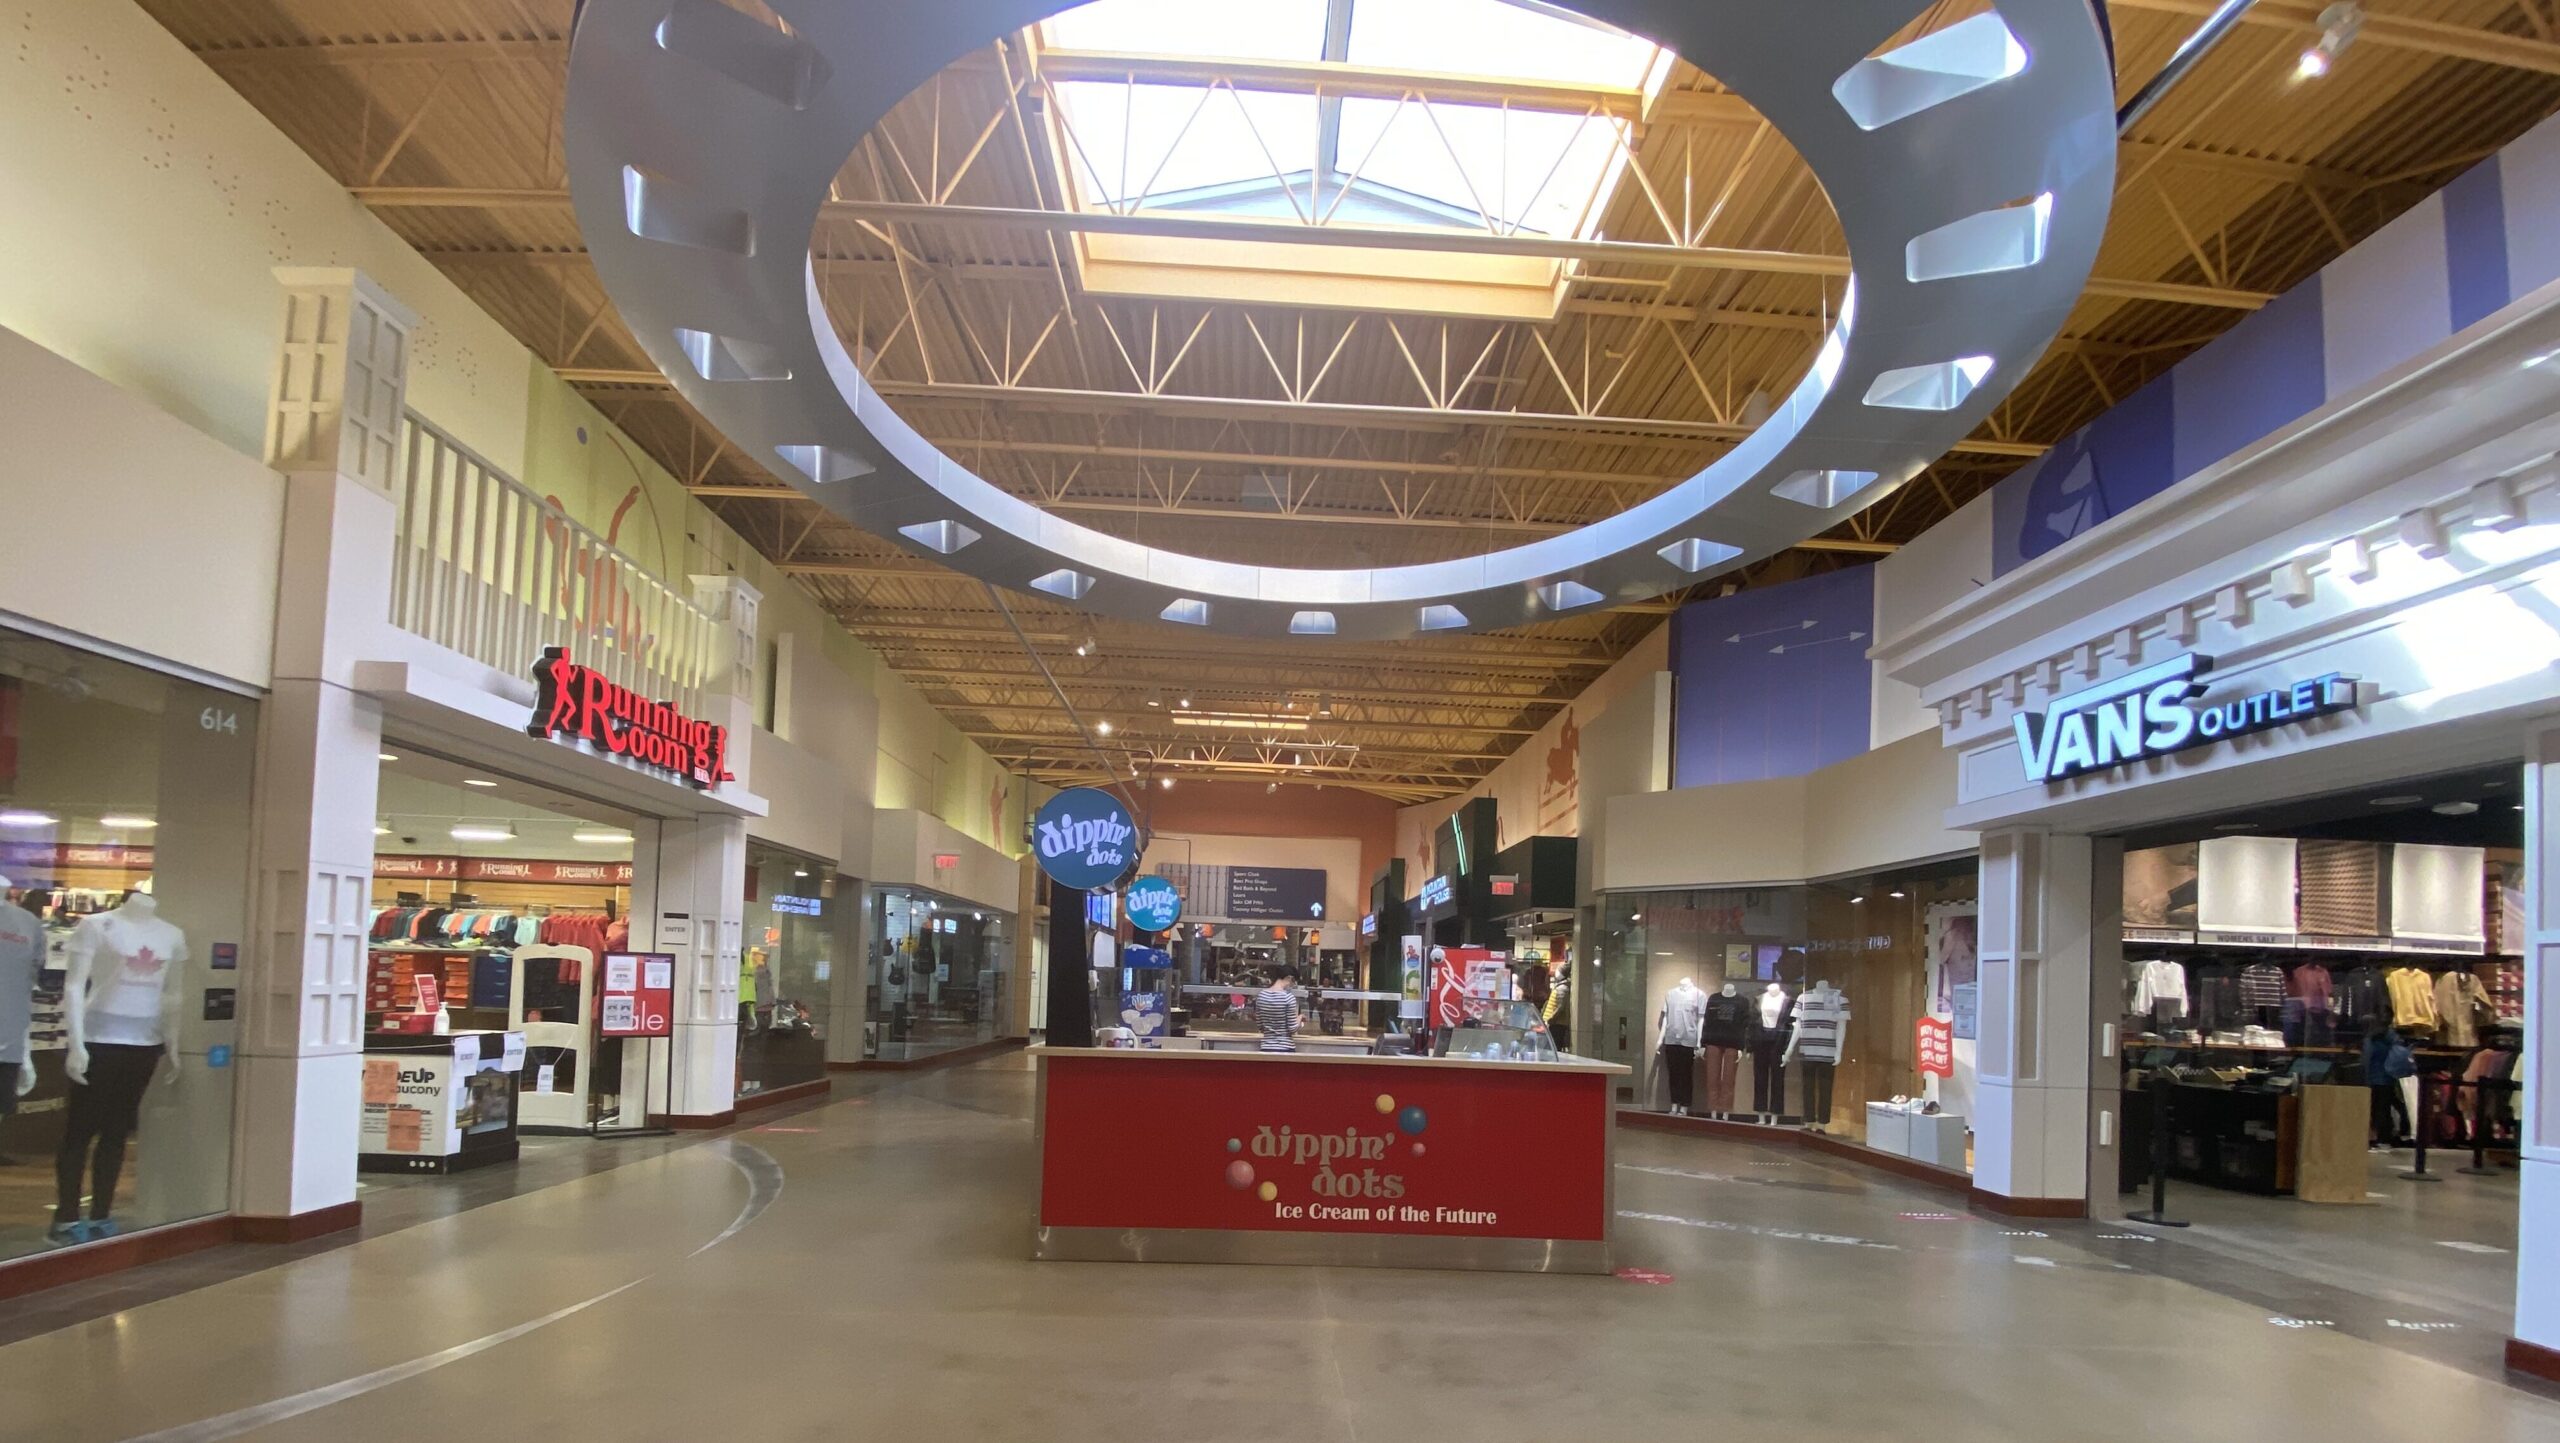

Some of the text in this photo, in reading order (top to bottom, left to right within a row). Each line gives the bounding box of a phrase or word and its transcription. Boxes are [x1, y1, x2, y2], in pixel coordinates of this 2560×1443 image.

[200, 707, 238, 735] 614
[579, 664, 712, 768] Running
[2012, 652, 2342, 783] VANS OUTLET
[1038, 811, 1131, 858] dippin'
[1086, 848, 1123, 866] dots
[2216, 934, 2276, 943] WOMENS SALE
[631, 1000, 664, 1031] ale
[1920, 1025, 1948, 1040] BUY ONE
[1920, 1037, 1948, 1052] GET ONE
[1921, 1050, 1948, 1064] 50% OFF
[395, 1084, 441, 1097] aucony
[1251, 1125, 1395, 1165] dippin'
[1311, 1165, 1405, 1199] dots
[1275, 1202, 1497, 1224] Ice Cream of the Future
